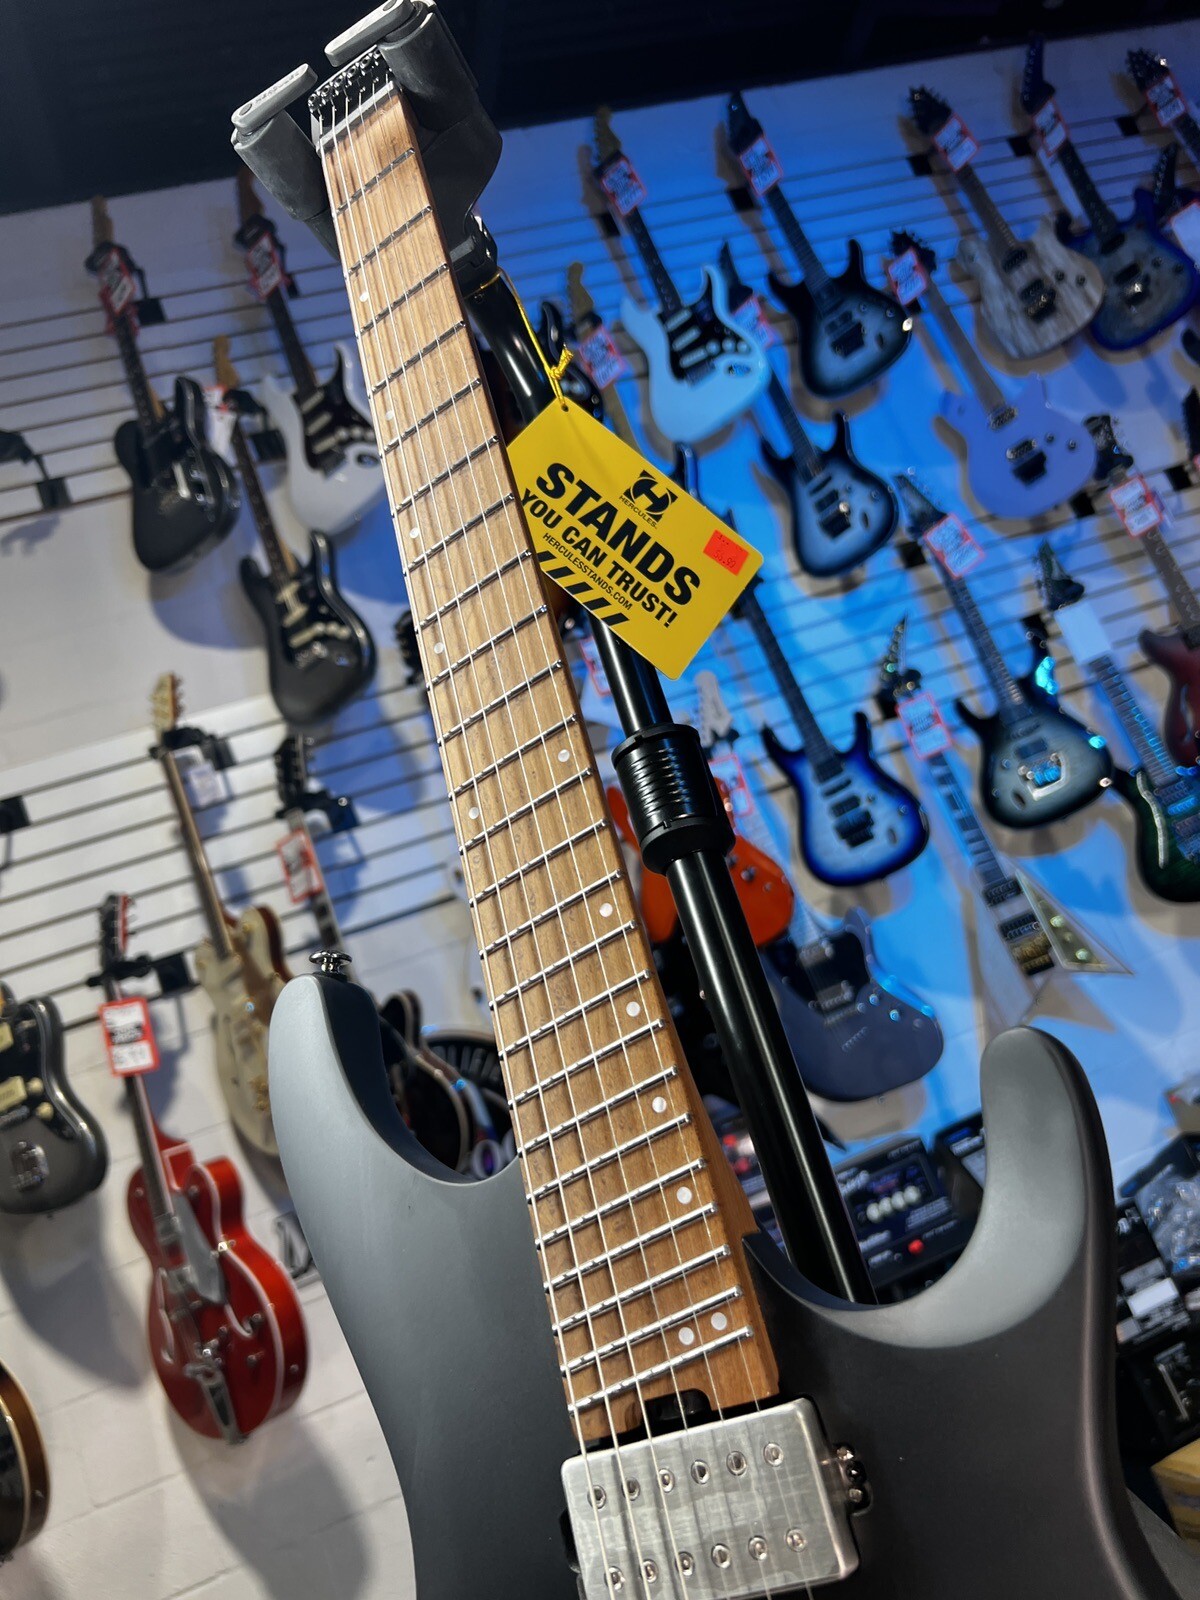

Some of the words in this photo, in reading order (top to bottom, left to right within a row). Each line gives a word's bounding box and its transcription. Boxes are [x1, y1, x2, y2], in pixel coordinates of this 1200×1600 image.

[521, 487, 563, 529] YOU
[561, 525, 608, 568] CAN
[606, 560, 678, 628] TRUST!
[536, 462, 700, 605] STANDS
[619, 495, 657, 528] HERCULES
[542, 532, 632, 611] HERCULESSTANDS.COM
